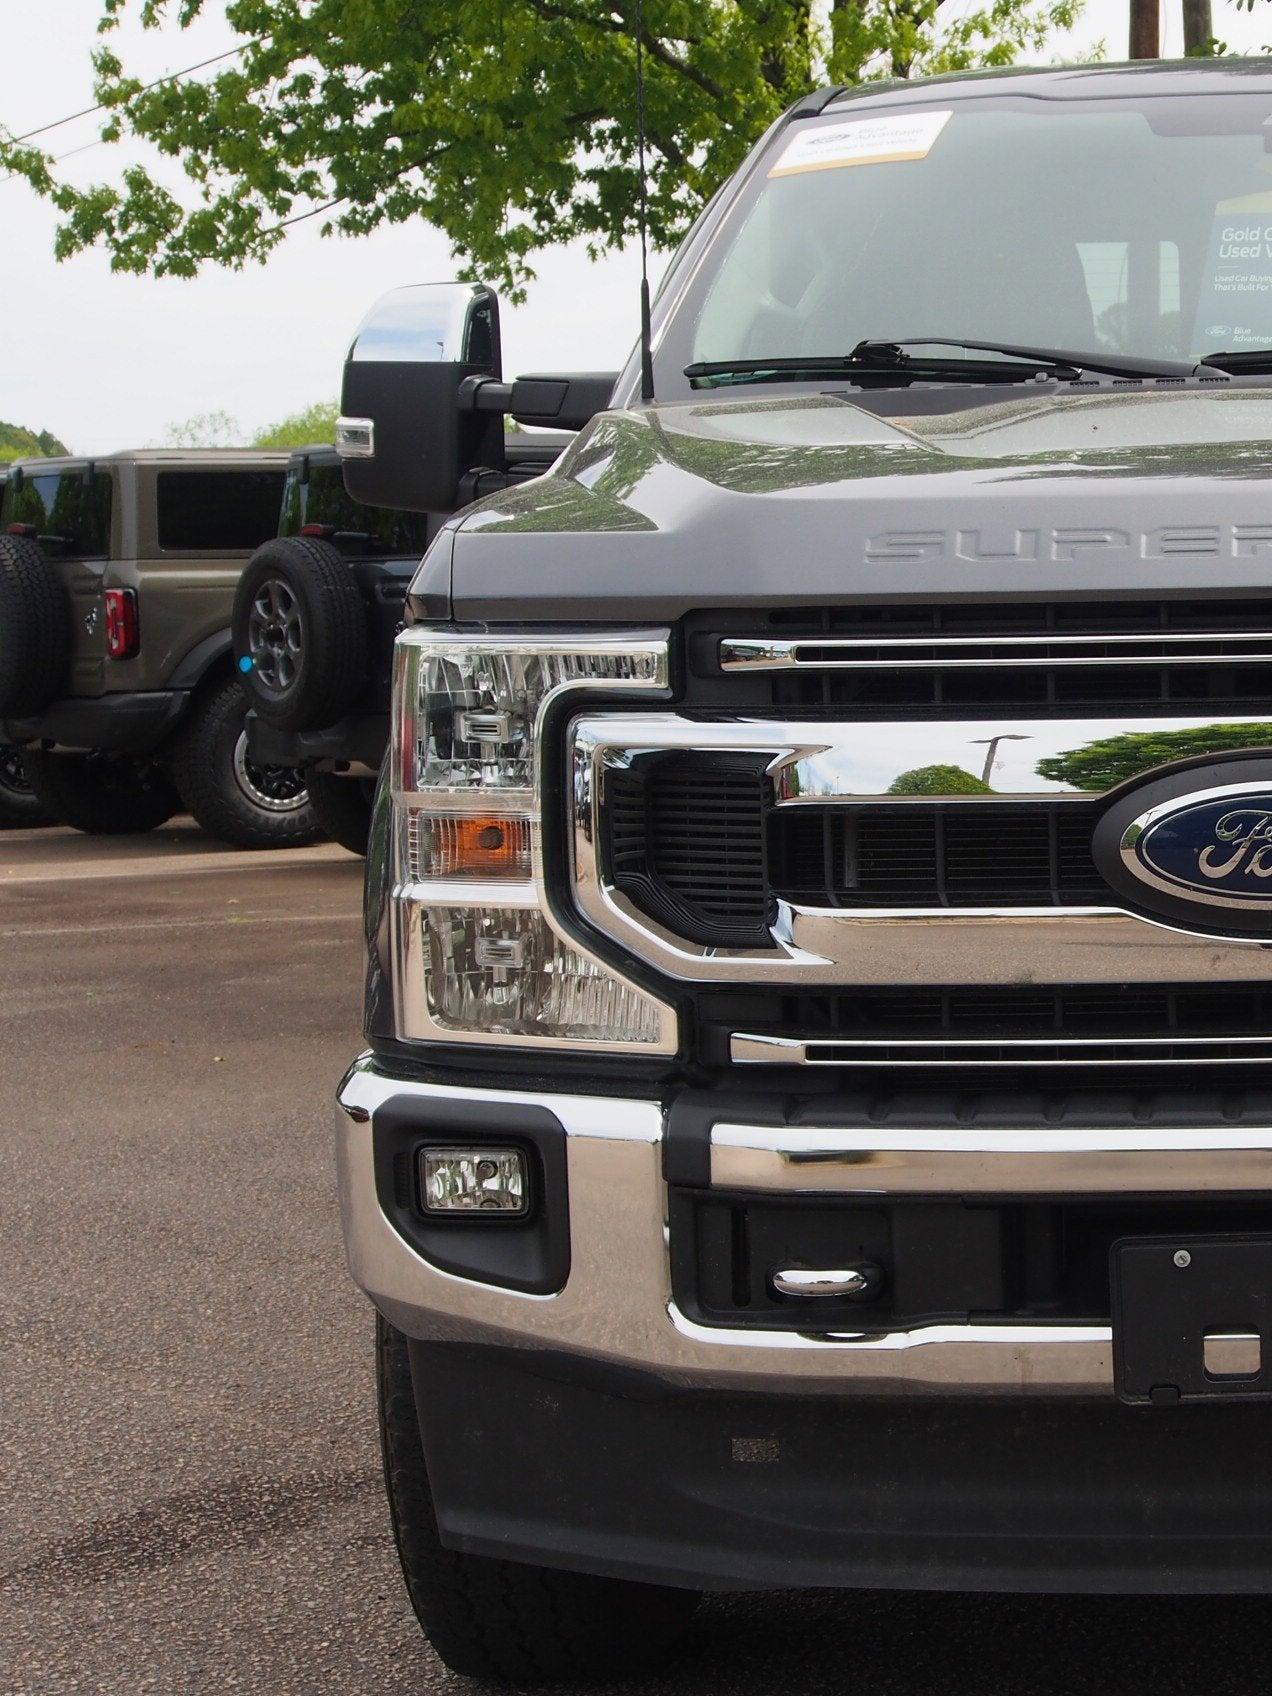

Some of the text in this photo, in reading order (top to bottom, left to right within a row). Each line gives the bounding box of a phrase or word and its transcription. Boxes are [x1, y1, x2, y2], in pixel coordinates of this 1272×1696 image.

[1222, 226, 1261, 242] Gold
[1219, 243, 1261, 258] Used
[1214, 274, 1235, 283] Used
[1235, 275, 1248, 283] Car
[1213, 283, 1236, 291] That's
[1237, 283, 1255, 291] Built
[1233, 326, 1252, 335] Blue
